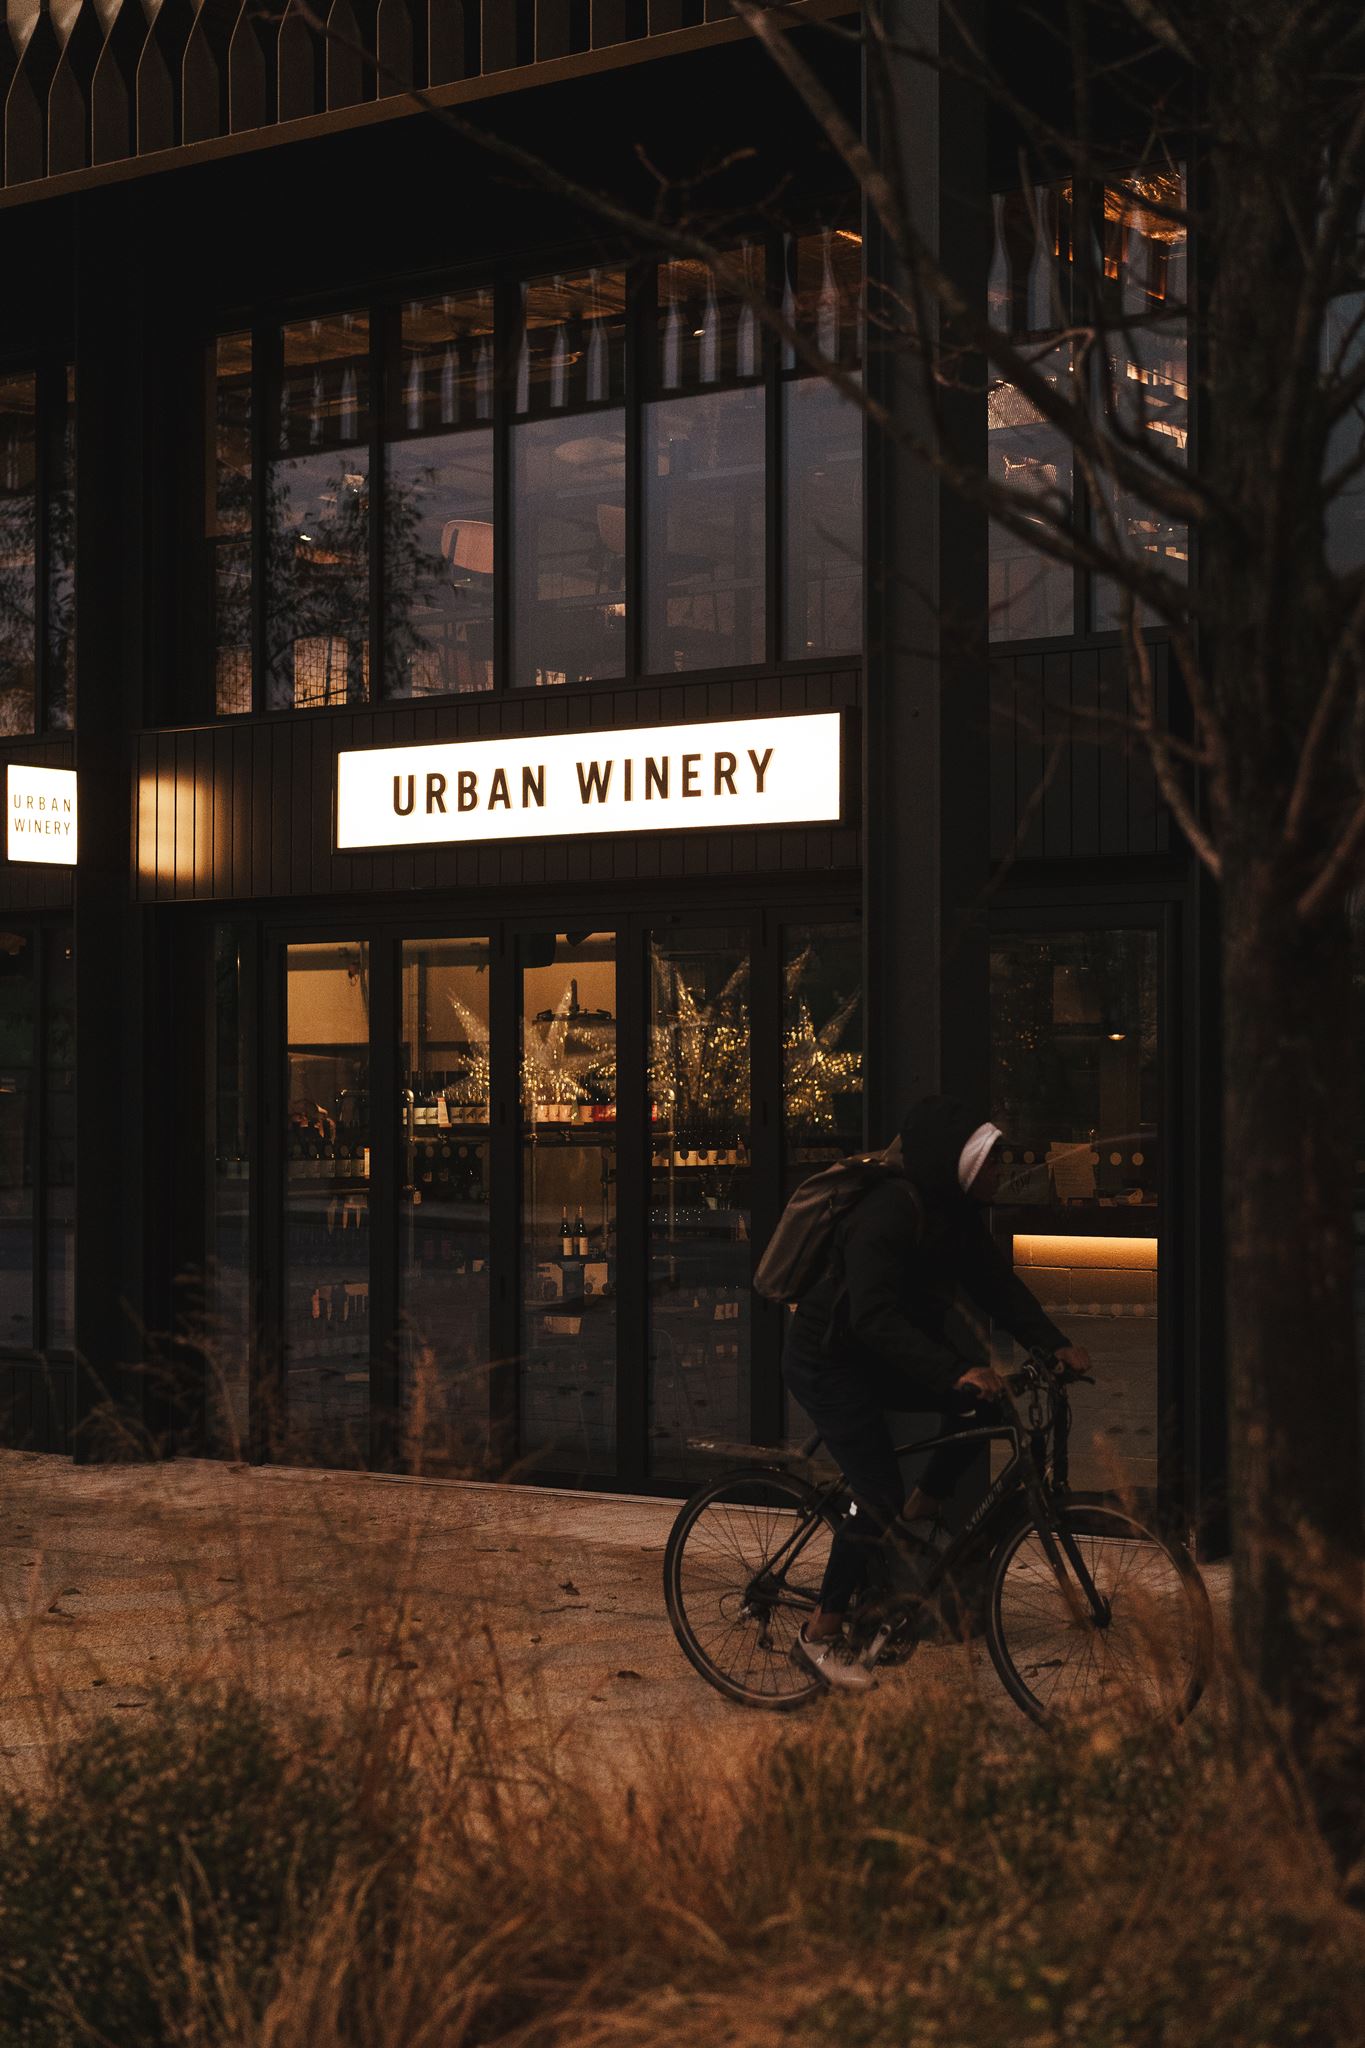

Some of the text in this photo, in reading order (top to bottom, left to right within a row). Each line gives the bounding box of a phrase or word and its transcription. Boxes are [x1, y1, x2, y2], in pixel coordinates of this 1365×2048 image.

[393, 748, 775, 816] URBAN WINERY
[14, 794, 71, 813] URBAN
[14, 818, 70, 836] WINERY
